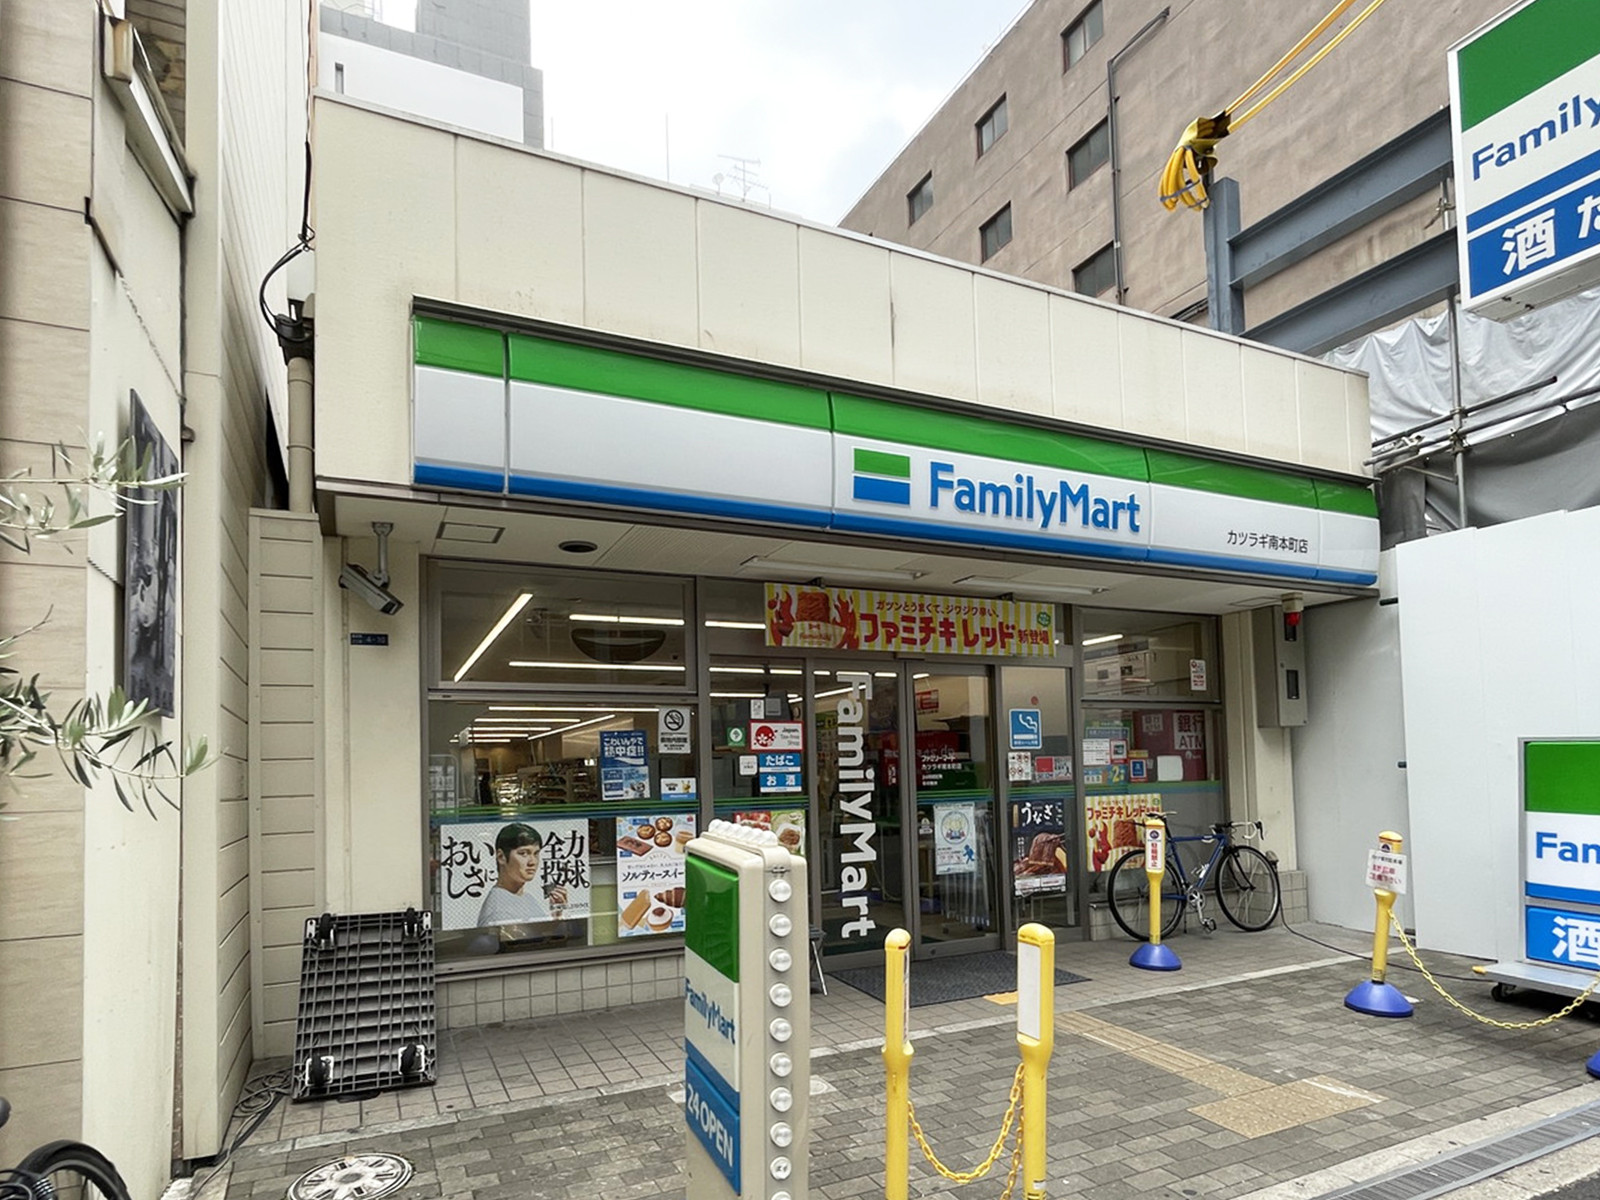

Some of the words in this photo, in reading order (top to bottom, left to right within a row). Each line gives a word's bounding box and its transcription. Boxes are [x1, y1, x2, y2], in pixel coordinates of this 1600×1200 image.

[1501, 207, 1556, 276] 酒
[930, 461, 1140, 533] FamilyMart
[1227, 530, 1309, 554] カツラギ南本町店
[1177, 714, 1204, 733] 銀行
[766, 755, 795, 766] たばこ
[836, 674, 877, 938] FamilyMart
[541, 830, 586, 860] 全力
[446, 866, 498, 899] しさに
[1551, 915, 1600, 966] 酒
[685, 977, 736, 1045] FamilyMart
